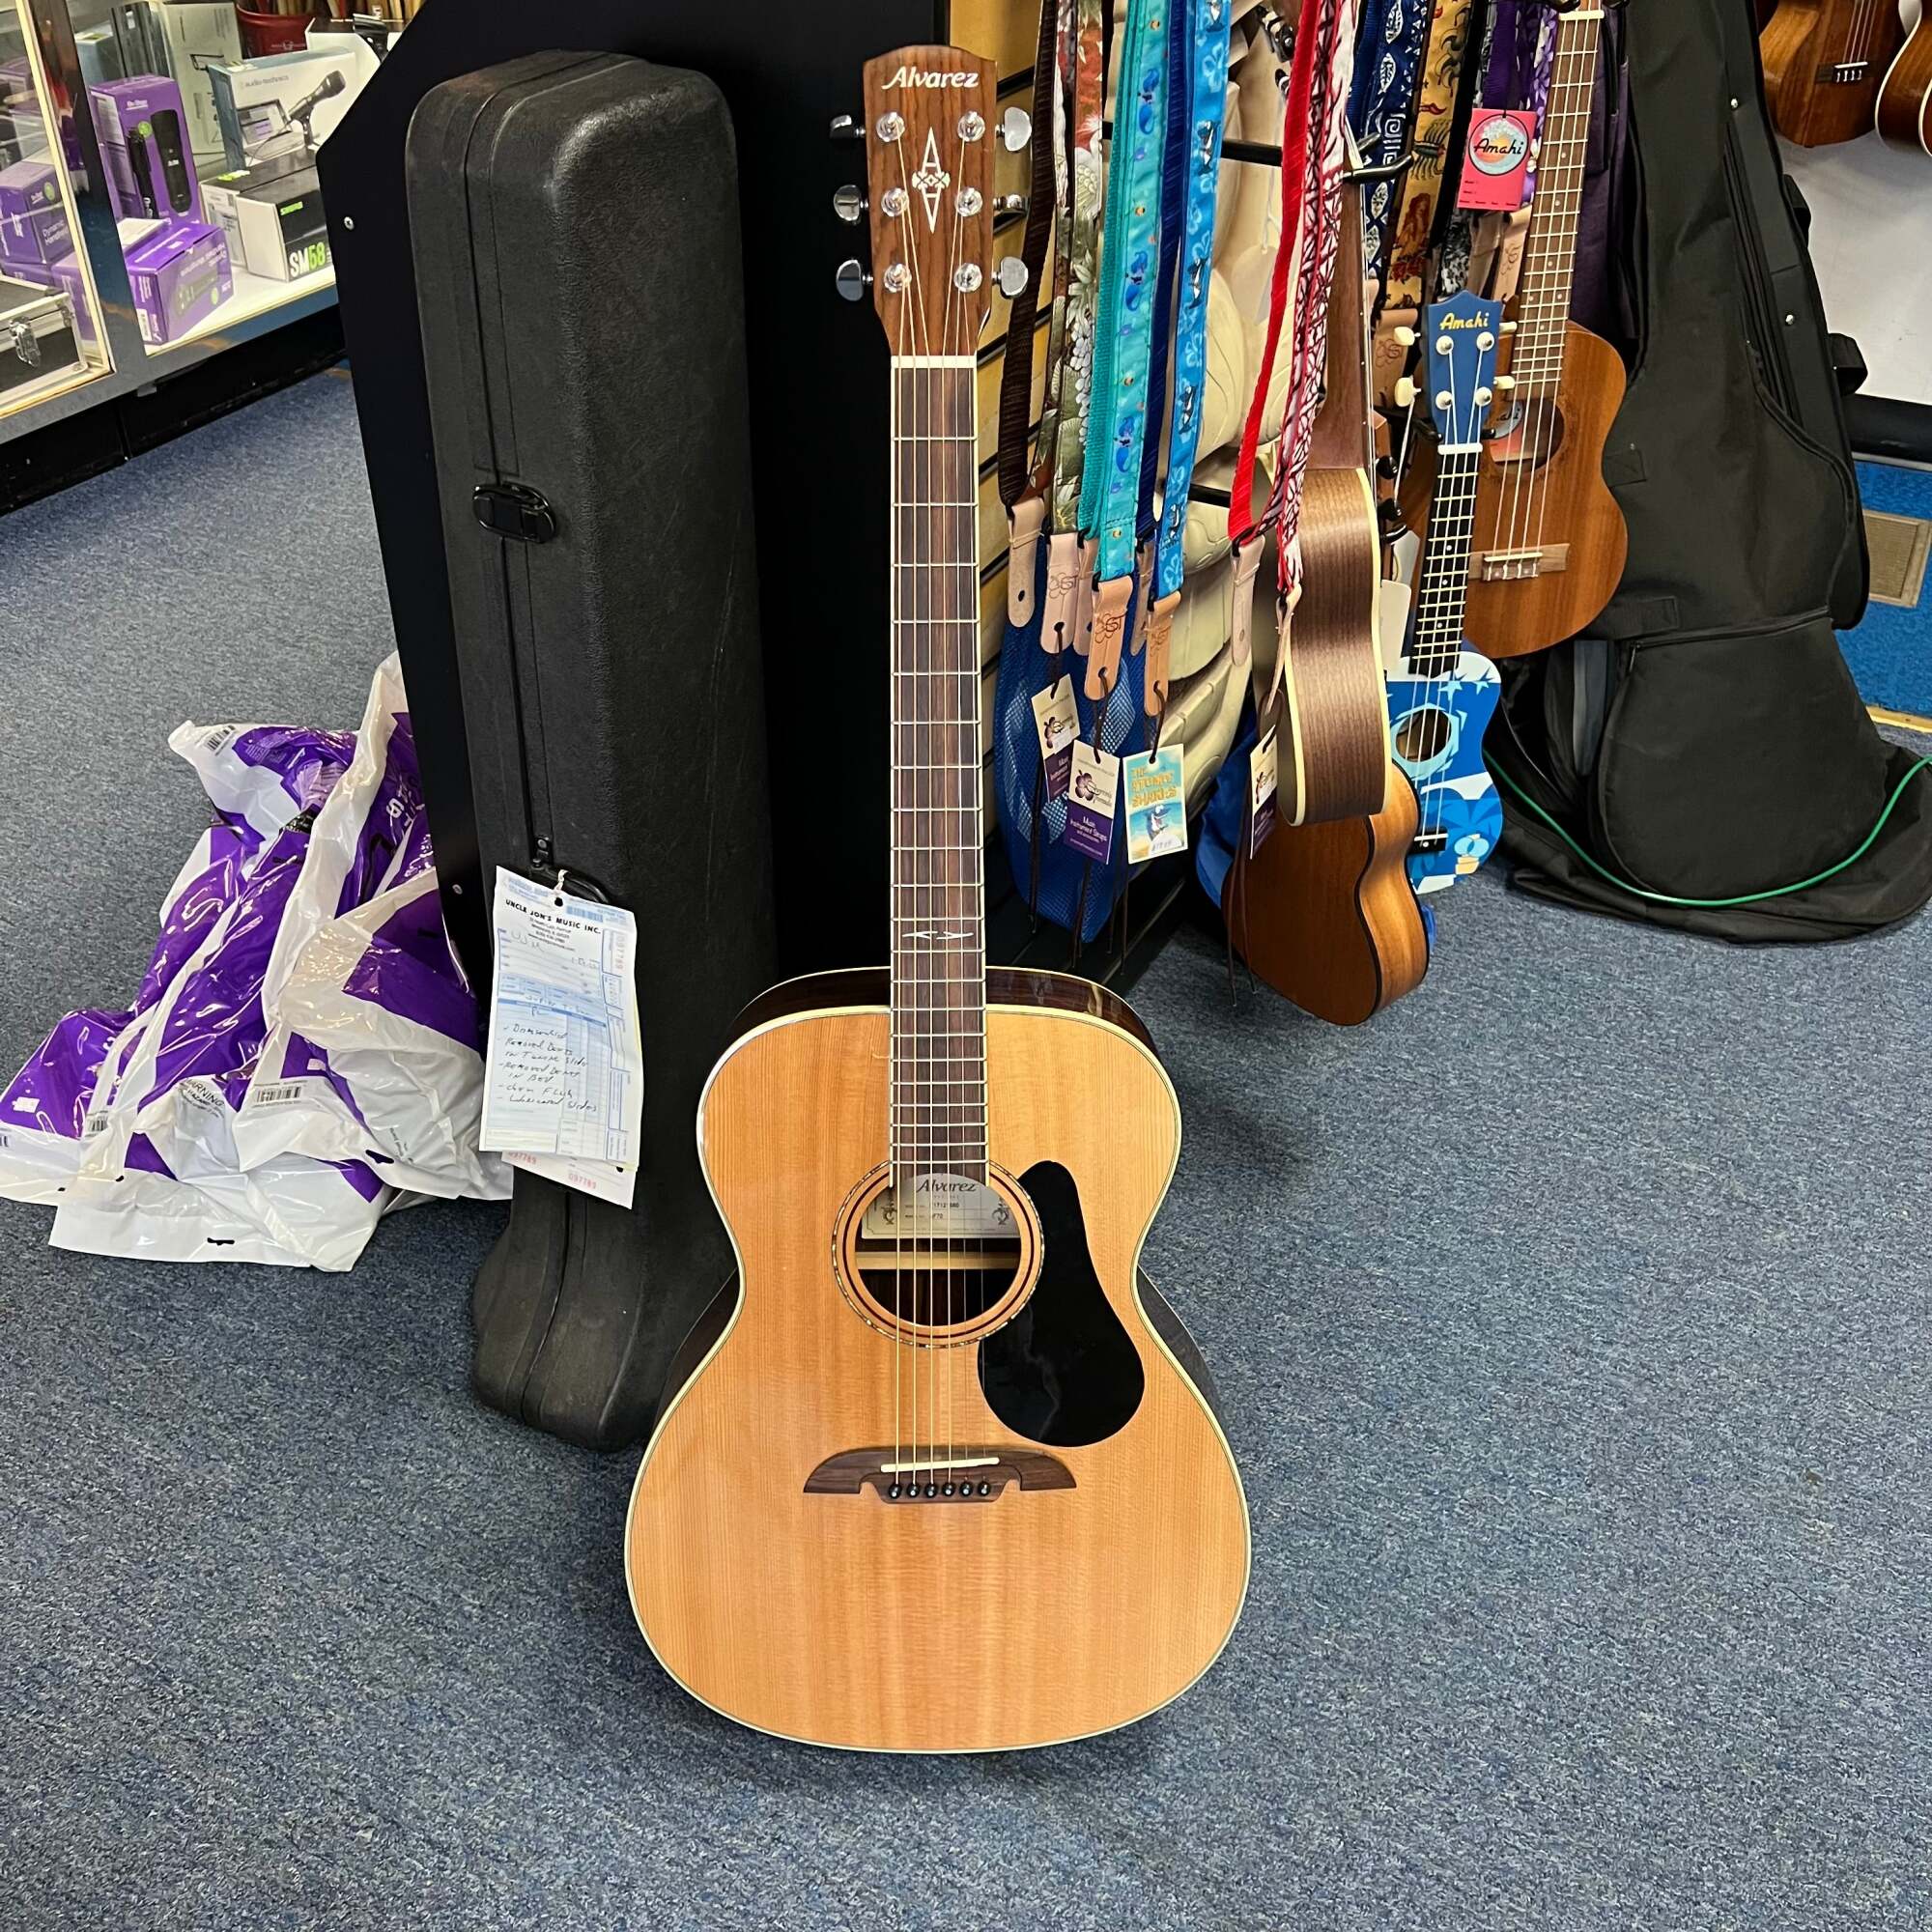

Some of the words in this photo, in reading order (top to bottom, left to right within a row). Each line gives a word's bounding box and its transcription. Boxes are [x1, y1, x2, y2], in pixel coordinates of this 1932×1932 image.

[881, 66, 980, 90] Alvarez
[1473, 137, 1524, 155] Amahi
[290, 242, 327, 278] SM58
[1439, 312, 1490, 330] Amahi
[505, 898, 527, 914] UNCLE
[529, 910, 552, 922] JON'S
[555, 917, 581, 929] MUSIC
[583, 924, 601, 934] INC.
[184, 1079, 225, 1107] ARNING
[917, 1179, 977, 1193] Alvarez
